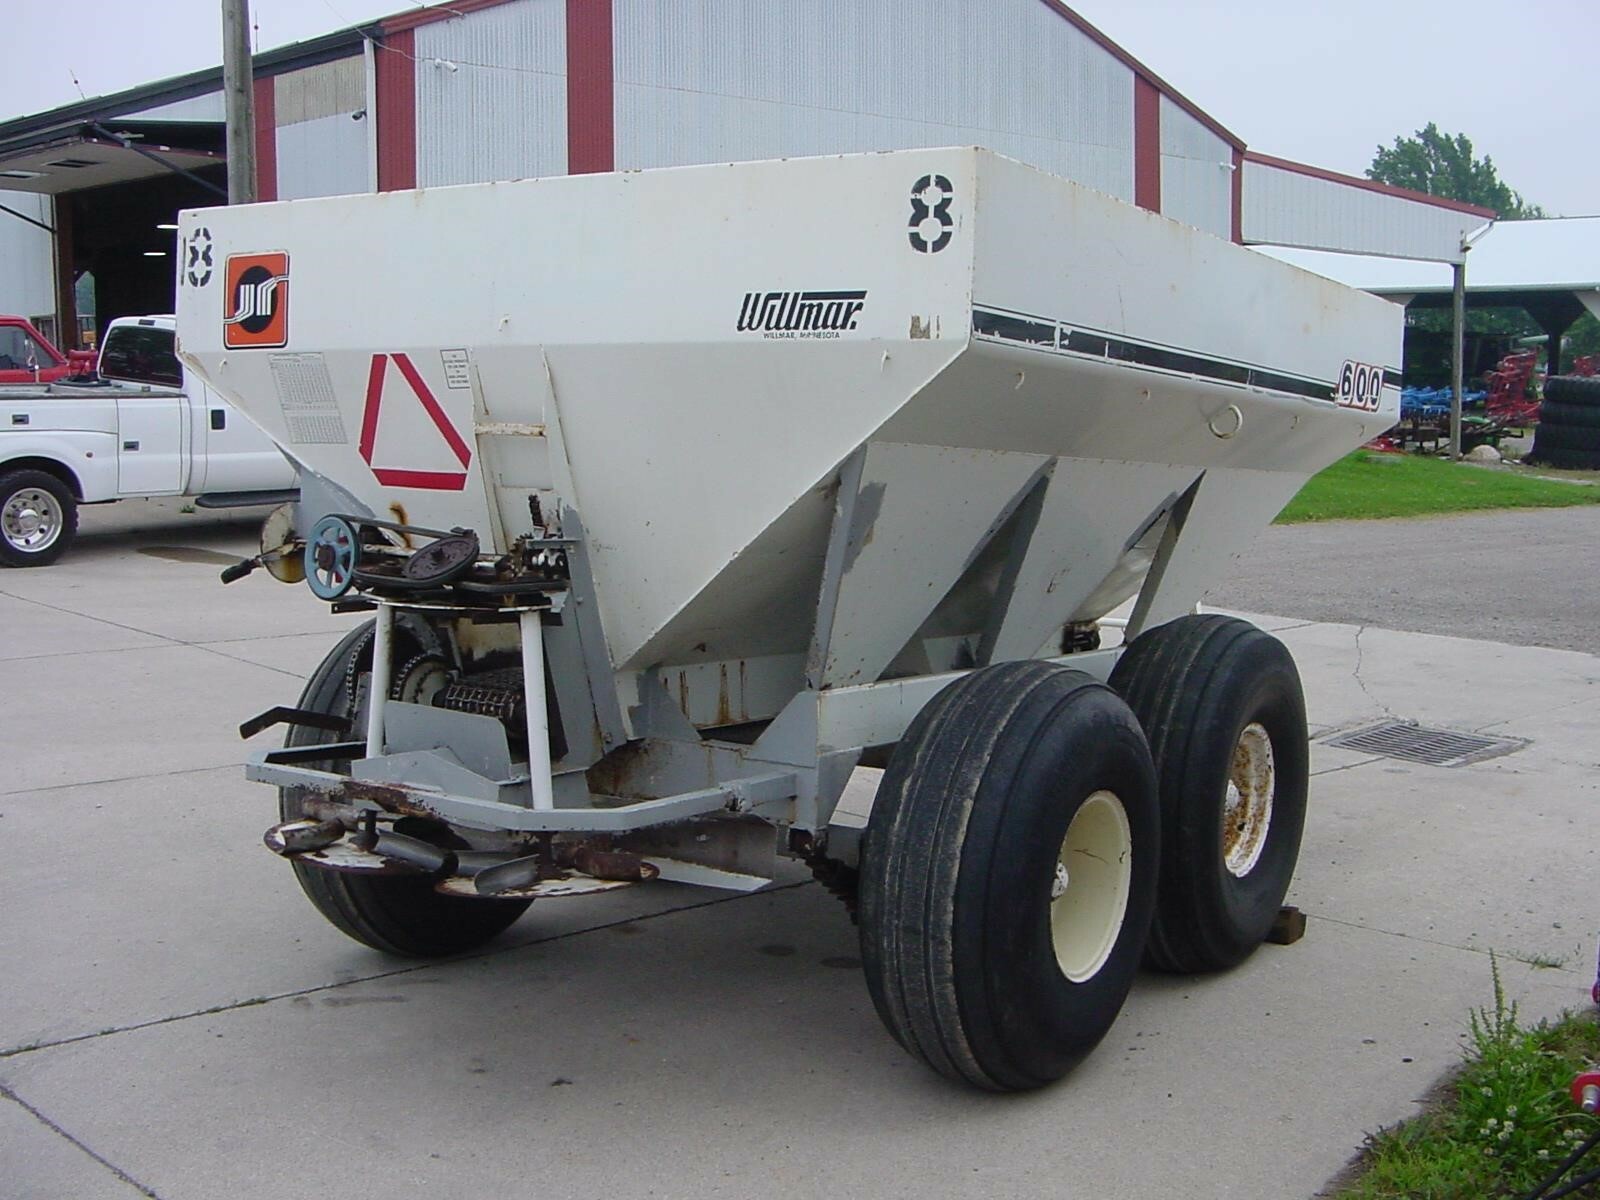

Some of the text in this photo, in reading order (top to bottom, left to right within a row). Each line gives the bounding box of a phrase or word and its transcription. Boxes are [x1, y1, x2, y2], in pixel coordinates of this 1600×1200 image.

[908, 174, 953, 253] 8
[188, 227, 212, 288] 8
[1341, 363, 1380, 406] 600
